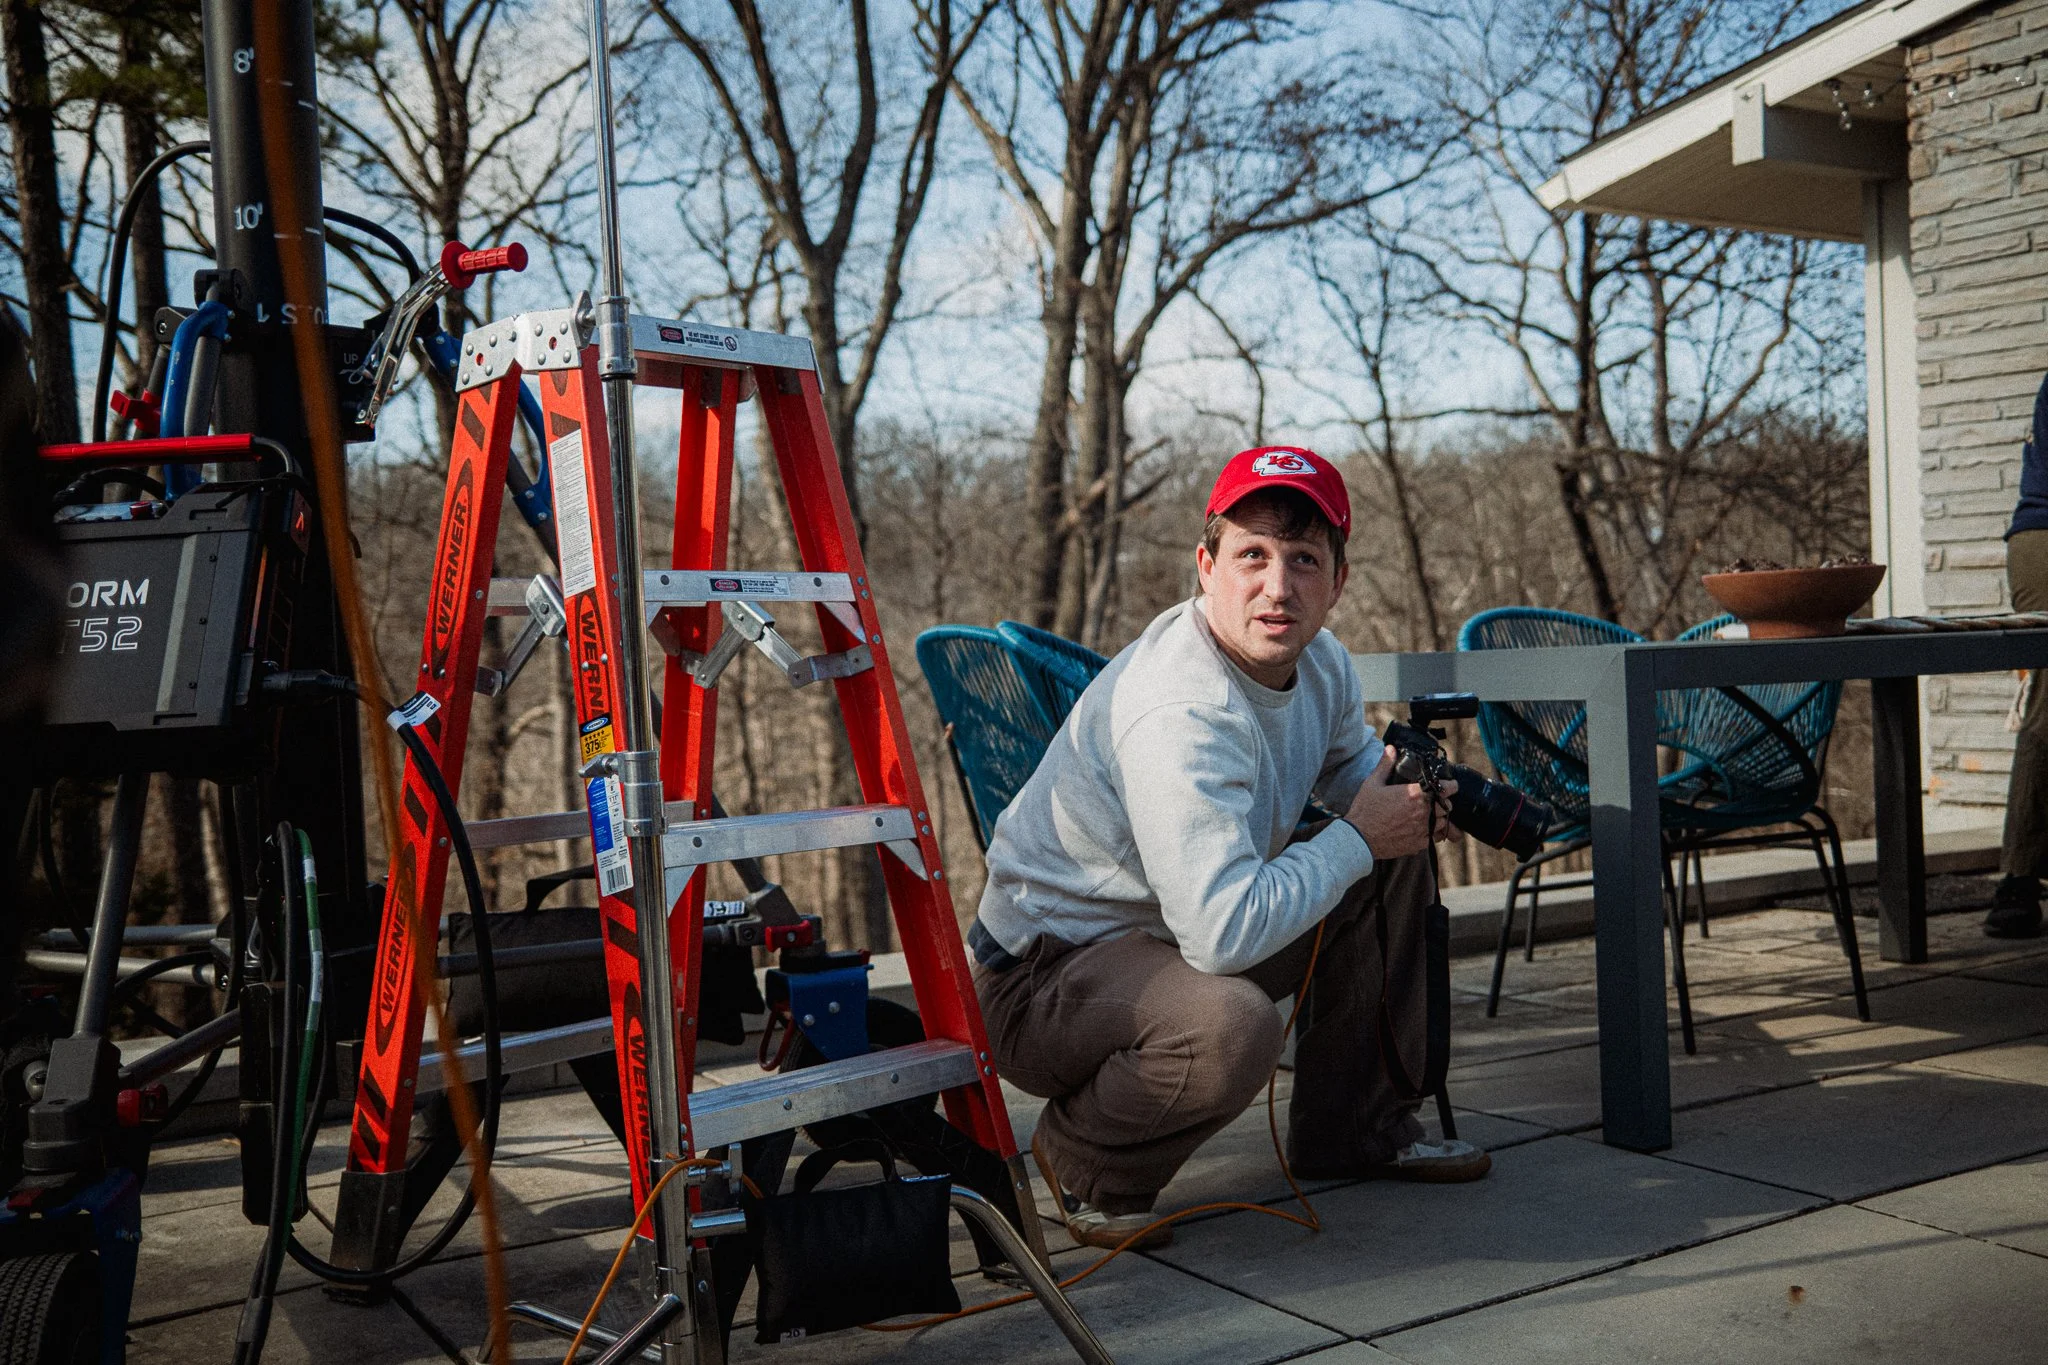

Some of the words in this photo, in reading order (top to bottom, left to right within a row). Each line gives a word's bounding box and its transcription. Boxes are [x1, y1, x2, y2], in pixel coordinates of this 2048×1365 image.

[234, 202, 263, 230] 10'
[343, 352, 359, 365] UP
[437, 501, 467, 634] WERNER
[66, 579, 150, 608] ORM
[581, 609, 605, 717] WERN
[585, 739, 600, 754] 375
